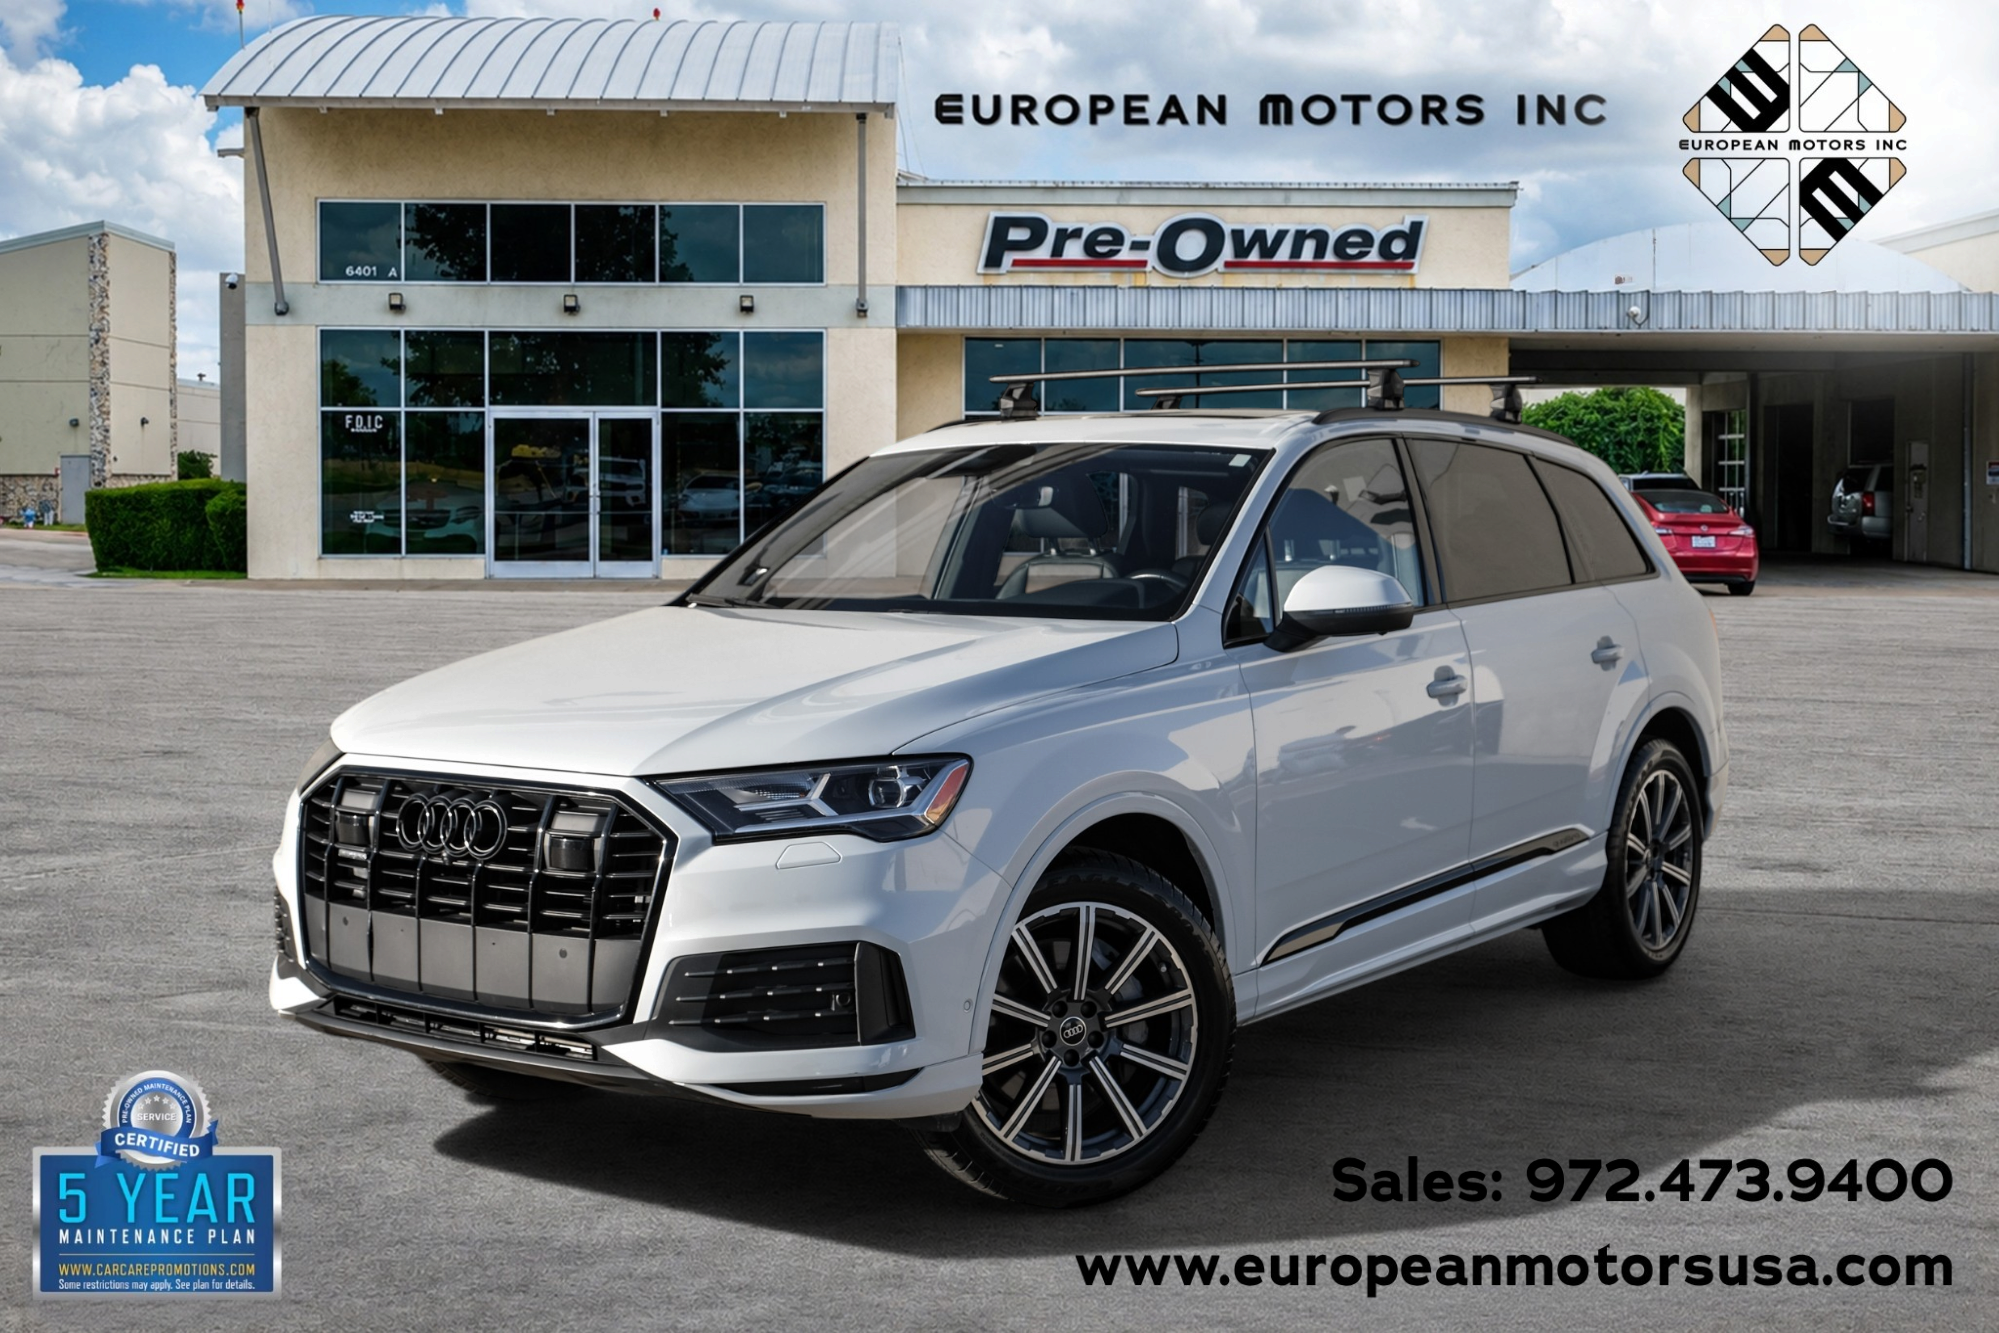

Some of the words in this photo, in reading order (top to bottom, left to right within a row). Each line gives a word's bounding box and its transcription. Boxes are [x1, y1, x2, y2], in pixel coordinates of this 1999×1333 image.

[983, 215, 1425, 272] Pre-Owned
[345, 265, 377, 277] 6401
[388, 267, 398, 277] A
